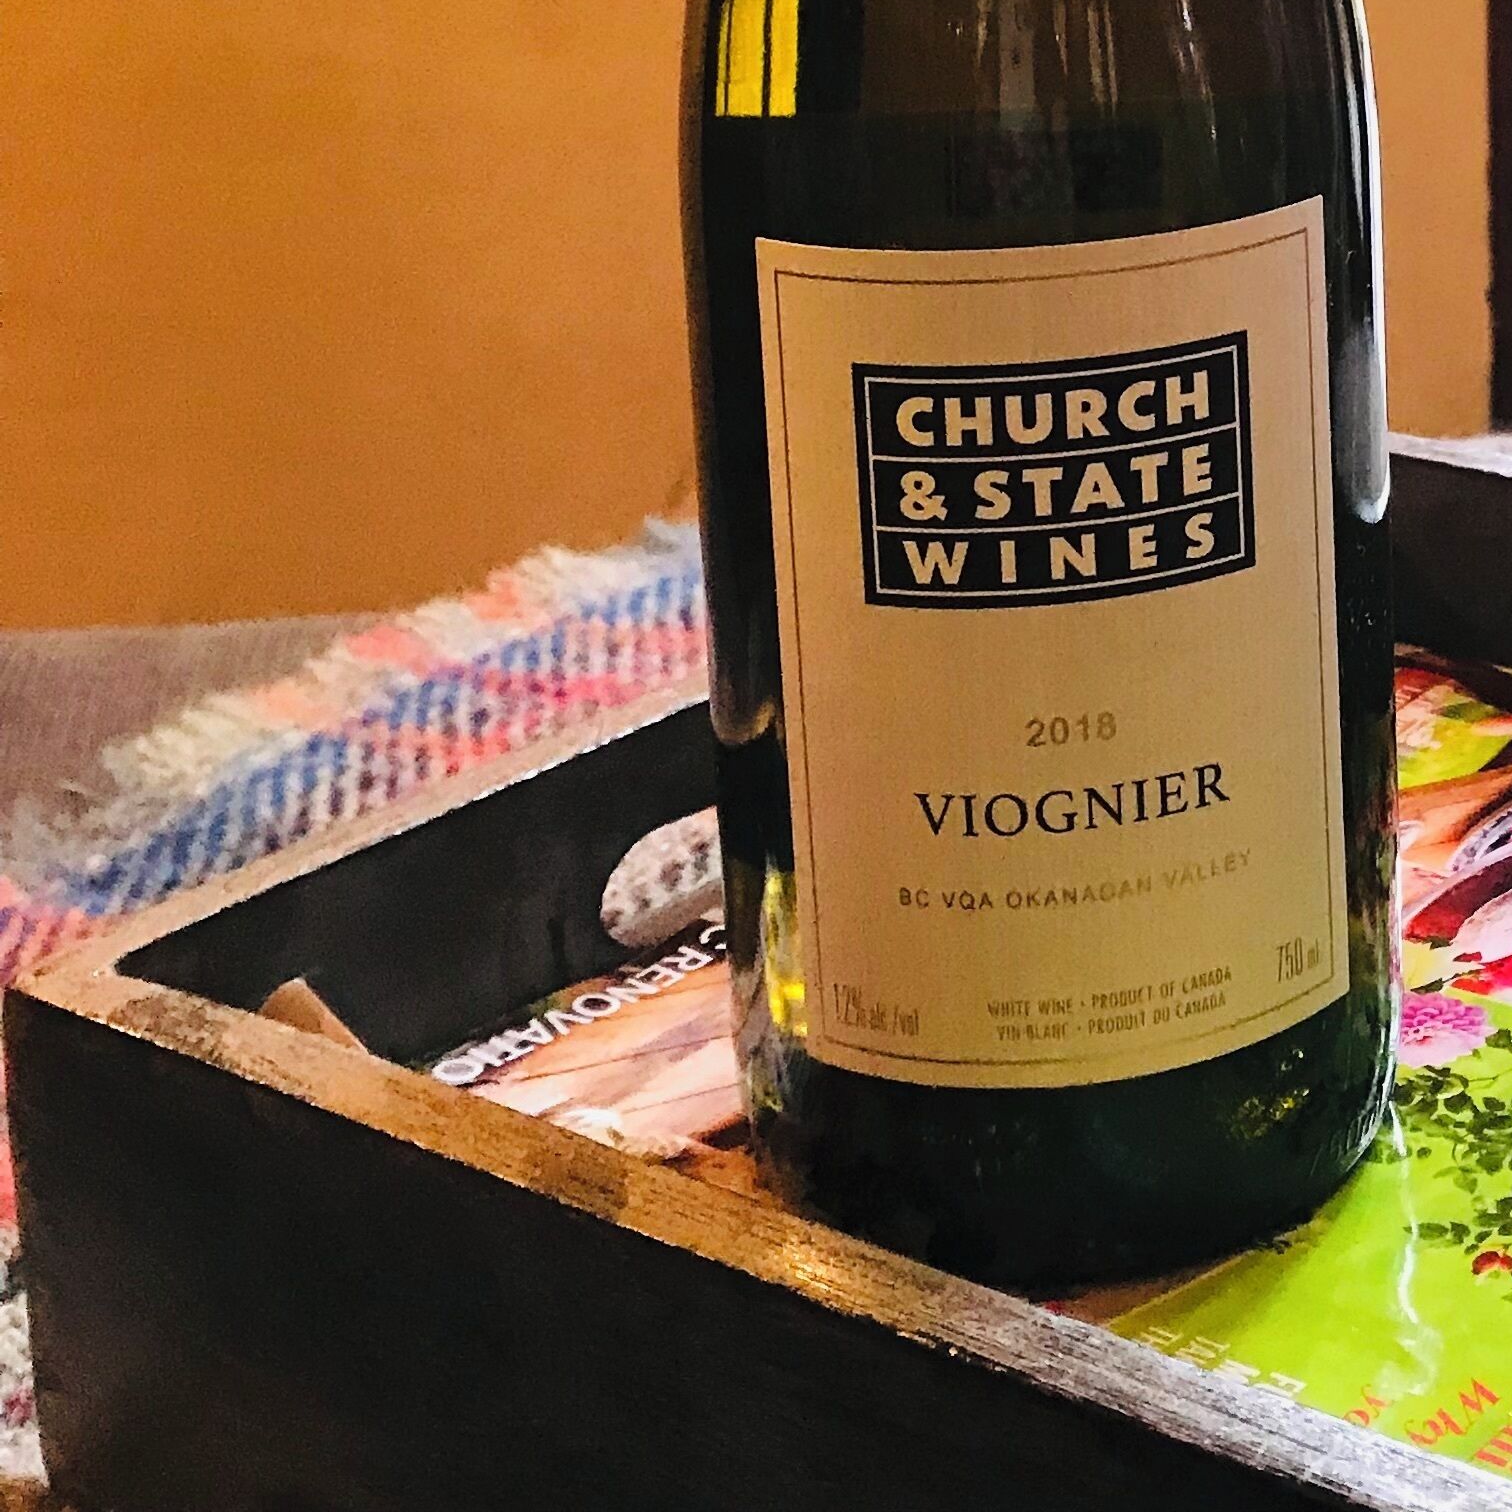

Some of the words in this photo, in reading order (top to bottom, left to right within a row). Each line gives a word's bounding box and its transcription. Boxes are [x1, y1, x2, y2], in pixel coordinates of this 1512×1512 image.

[896, 368, 1210, 447] CHURCH
[900, 470, 948, 522] &
[974, 443, 1213, 521] STATE
[903, 512, 1215, 585] WINES
[1024, 711, 1117, 748] 2018
[915, 761, 1230, 838] VIOGNIER
[899, 886, 930, 908] BC
[941, 889, 994, 911] VQA
[1005, 876, 1152, 910] OKANAGAN
[1163, 847, 1251, 889] VALLEY
[1276, 937, 1304, 983] 750
[987, 998, 1031, 1020] WHITE
[1038, 997, 1074, 1017] WINE
[1091, 985, 1152, 1011] PRODUCT
[1159, 981, 1176, 1001] OF
[1182, 965, 1232, 995] CANADA
[1088, 1011, 1146, 1036] PRODUIT
[1153, 1007, 1170, 1026] DU
[1175, 991, 1227, 1020] CANADA
